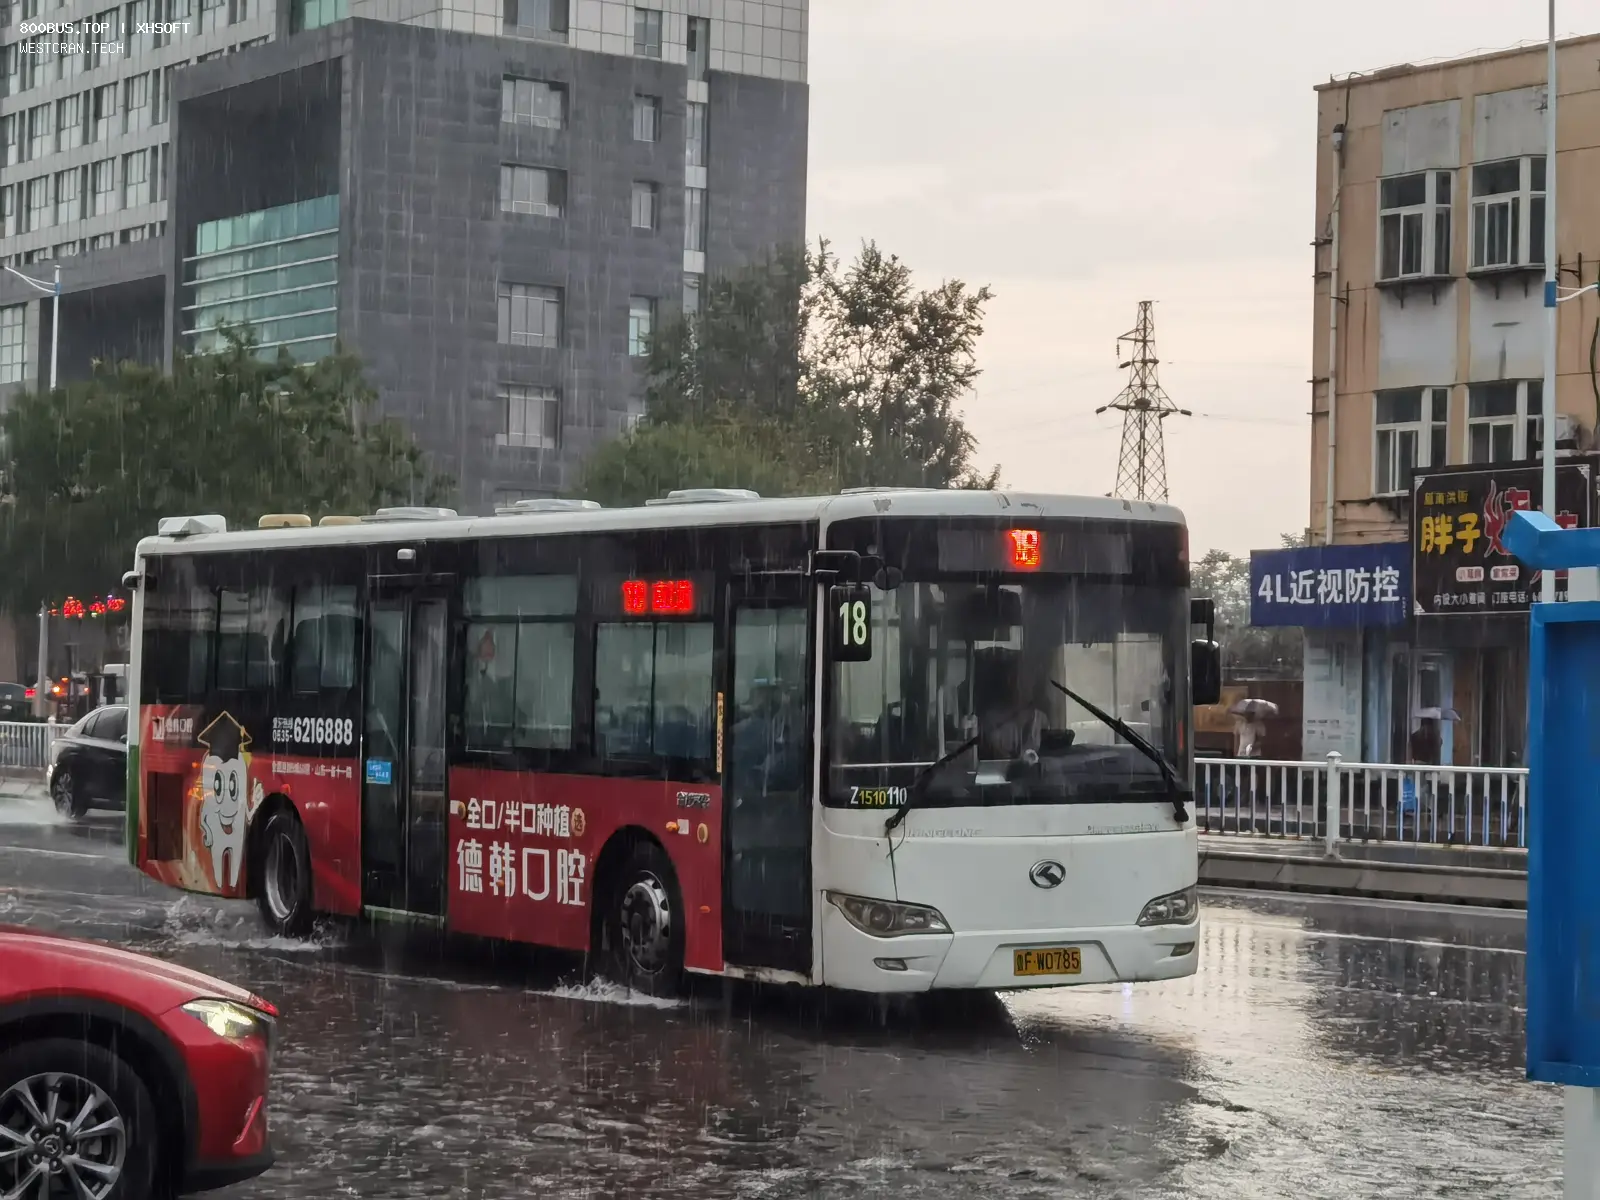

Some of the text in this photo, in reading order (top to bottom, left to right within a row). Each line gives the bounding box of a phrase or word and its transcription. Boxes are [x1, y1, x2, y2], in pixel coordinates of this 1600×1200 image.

[1258, 565, 1400, 605] 4L近视防控
[839, 600, 867, 646] 18
[293, 716, 353, 746] 6216888
[456, 838, 586, 907] 德韩口腔
